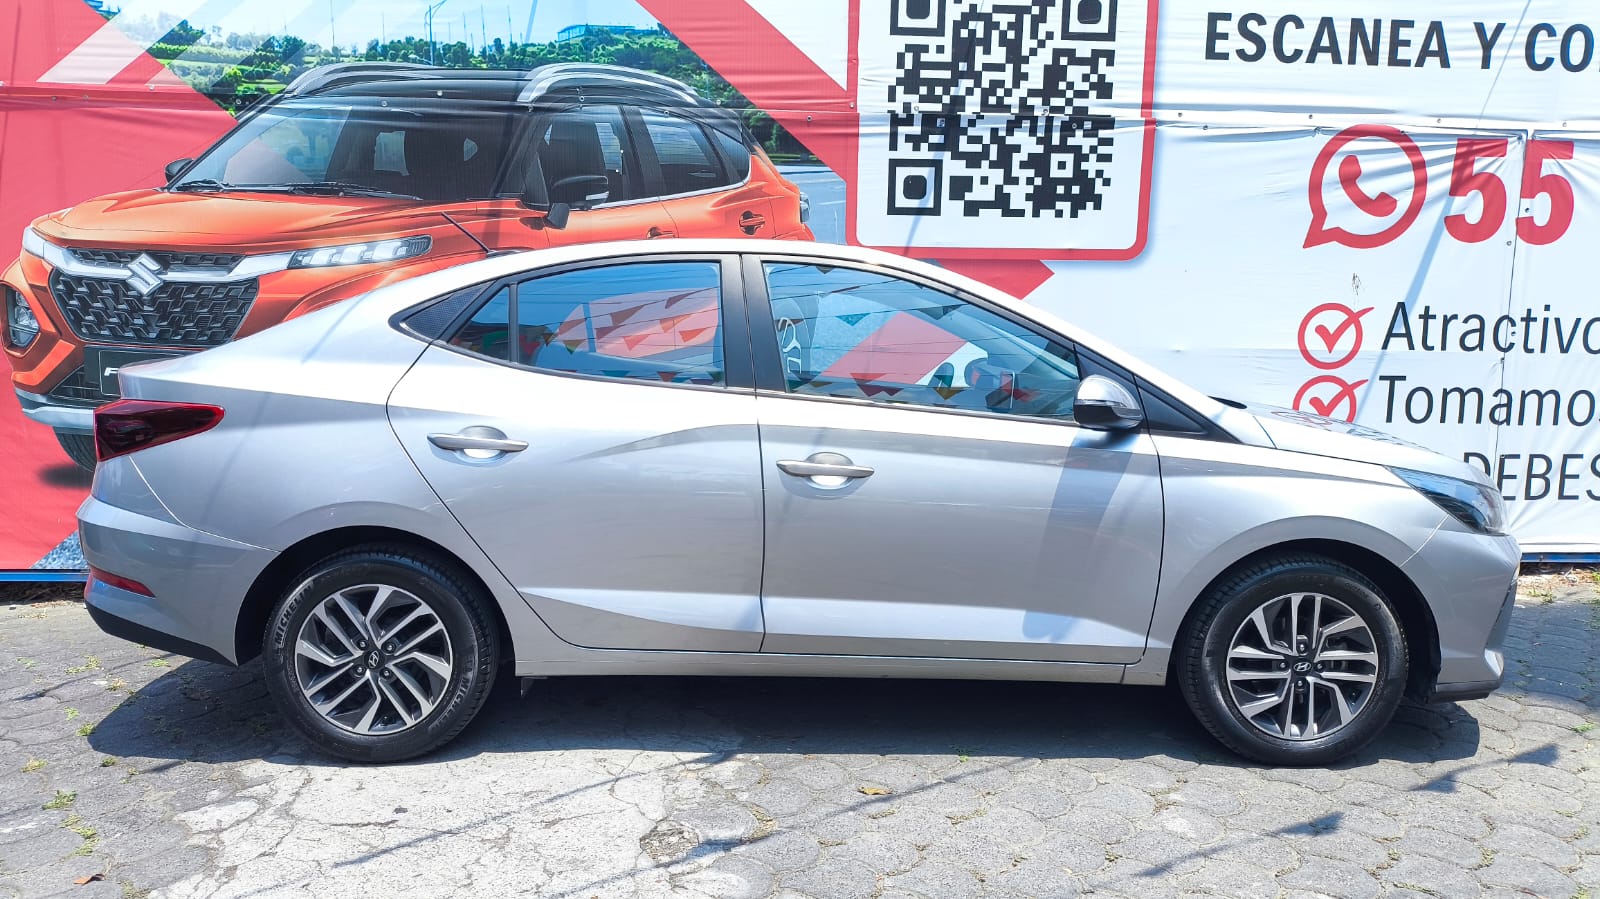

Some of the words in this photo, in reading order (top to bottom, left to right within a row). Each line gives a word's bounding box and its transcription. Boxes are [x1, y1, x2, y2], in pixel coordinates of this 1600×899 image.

[1204, 11, 1451, 69] ESCANEA
[1473, 22, 1507, 70] Y
[1524, 22, 1600, 73] CO
[1443, 137, 1575, 246] 55
[1378, 375, 1600, 427] Tomamo
[273, 581, 315, 647] MICHELIN
